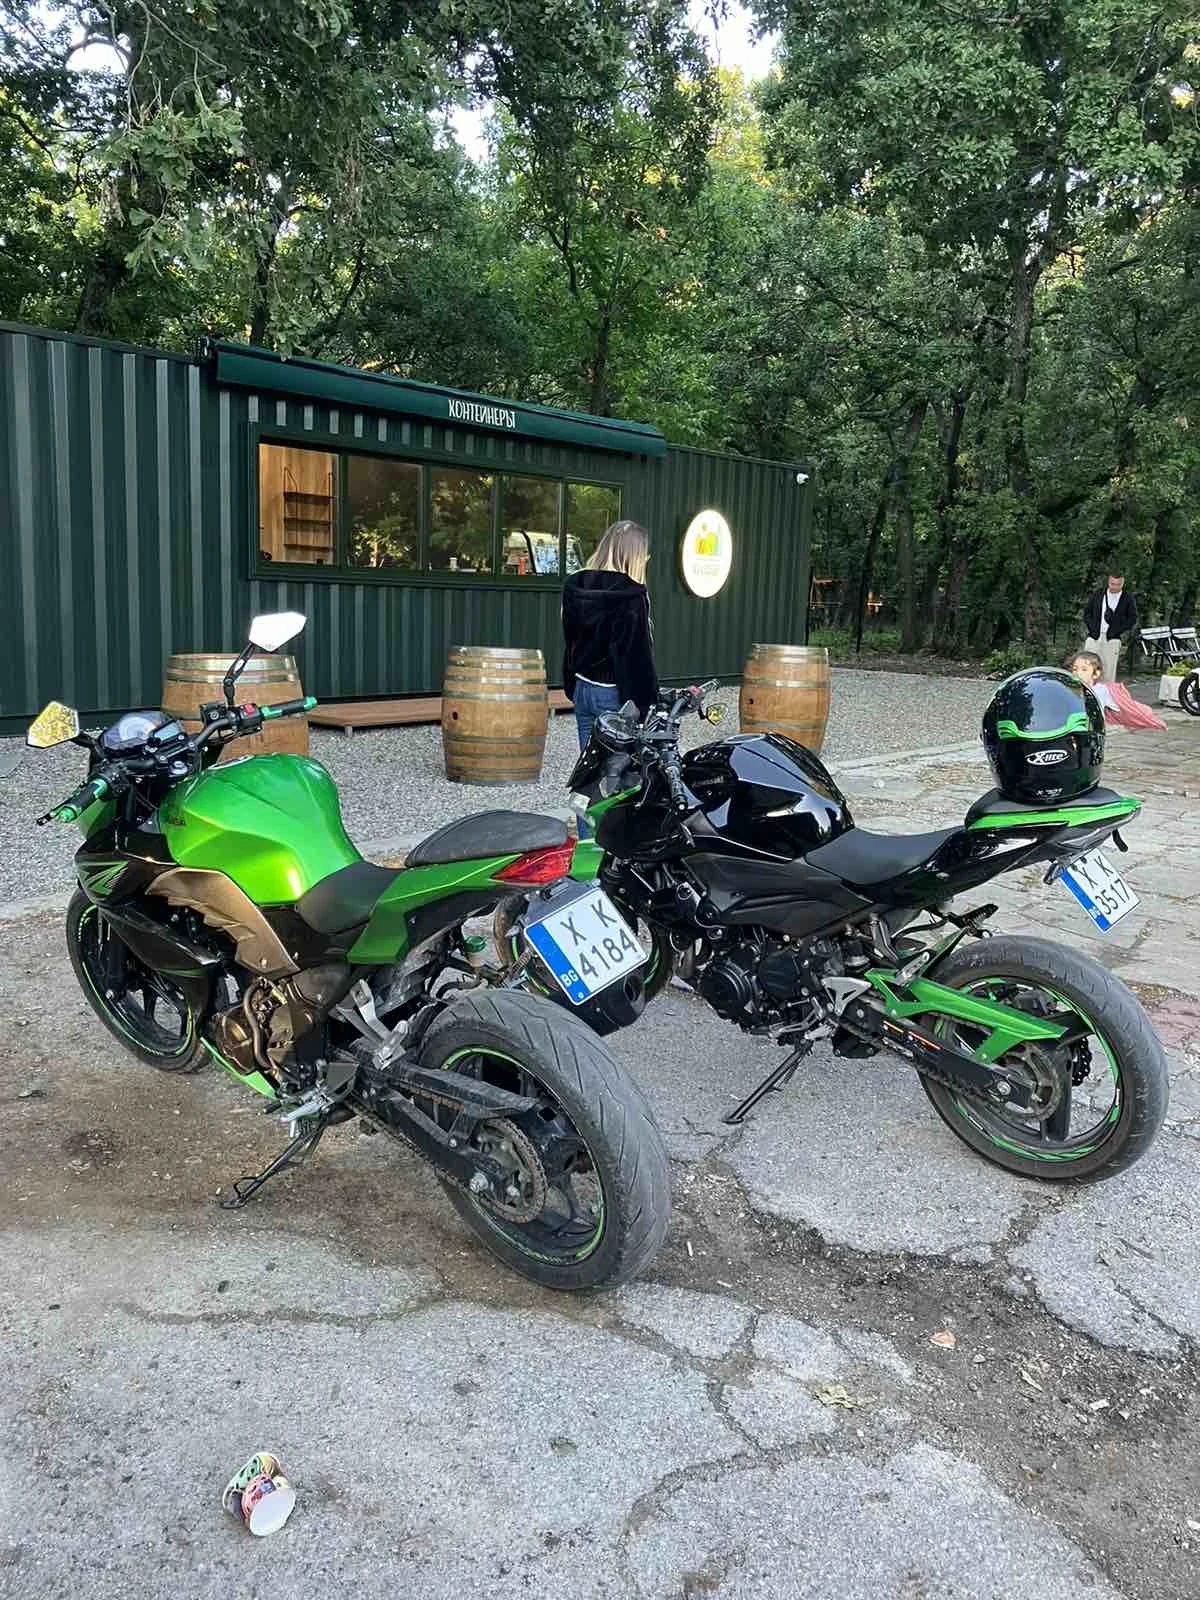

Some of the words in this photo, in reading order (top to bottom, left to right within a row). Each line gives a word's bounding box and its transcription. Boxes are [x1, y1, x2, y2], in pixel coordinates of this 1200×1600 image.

[1095, 878, 1130, 915] 3517
[579, 928, 638, 978] 4184
[560, 970, 579, 988] BG
